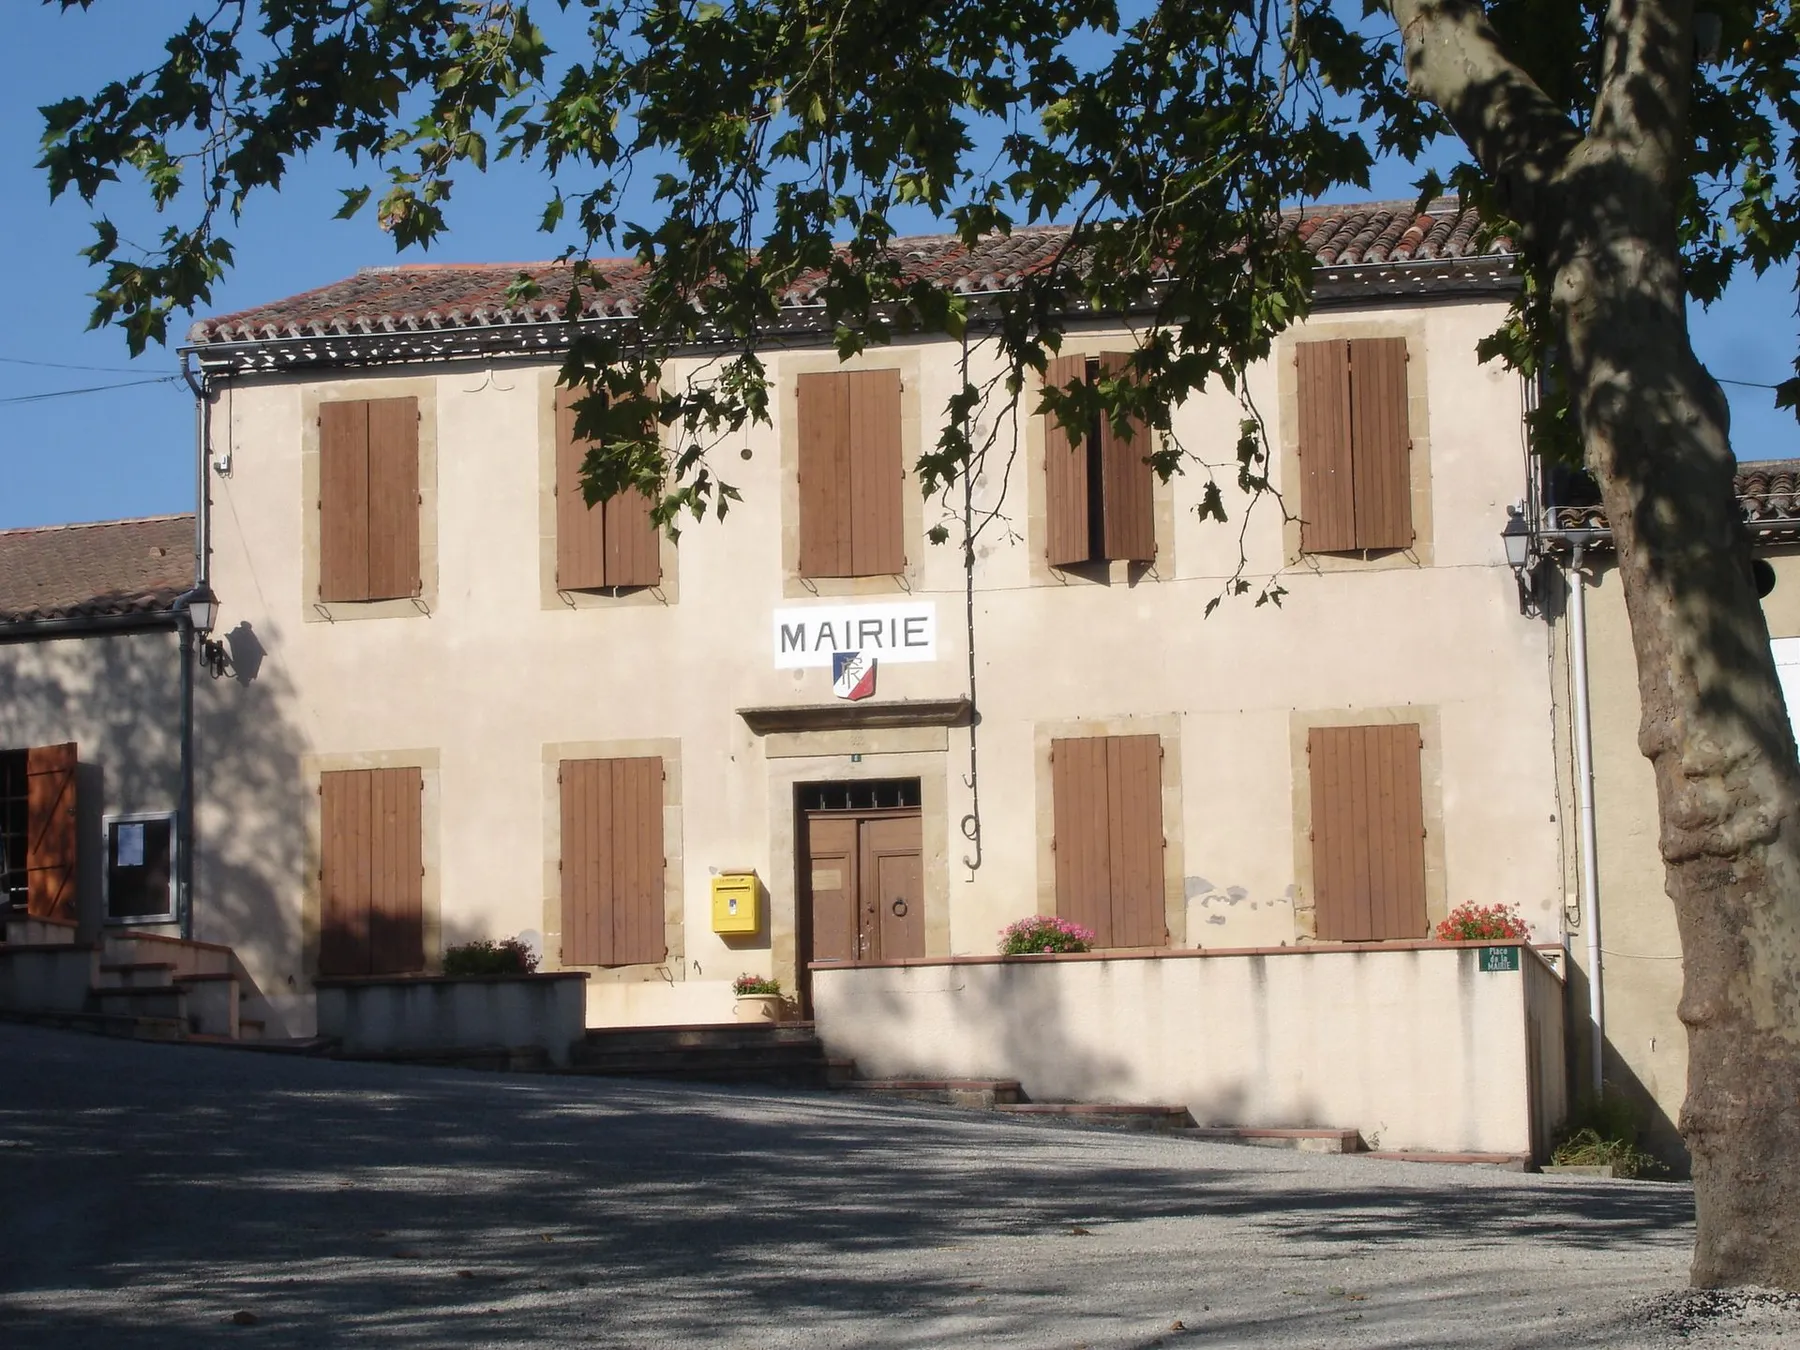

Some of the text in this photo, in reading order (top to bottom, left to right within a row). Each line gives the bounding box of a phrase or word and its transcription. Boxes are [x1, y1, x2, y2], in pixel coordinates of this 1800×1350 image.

[780, 616, 929, 653] MAIRIE
[1489, 947, 1508, 955] Place
[1488, 961, 1511, 970] MAIRIE
